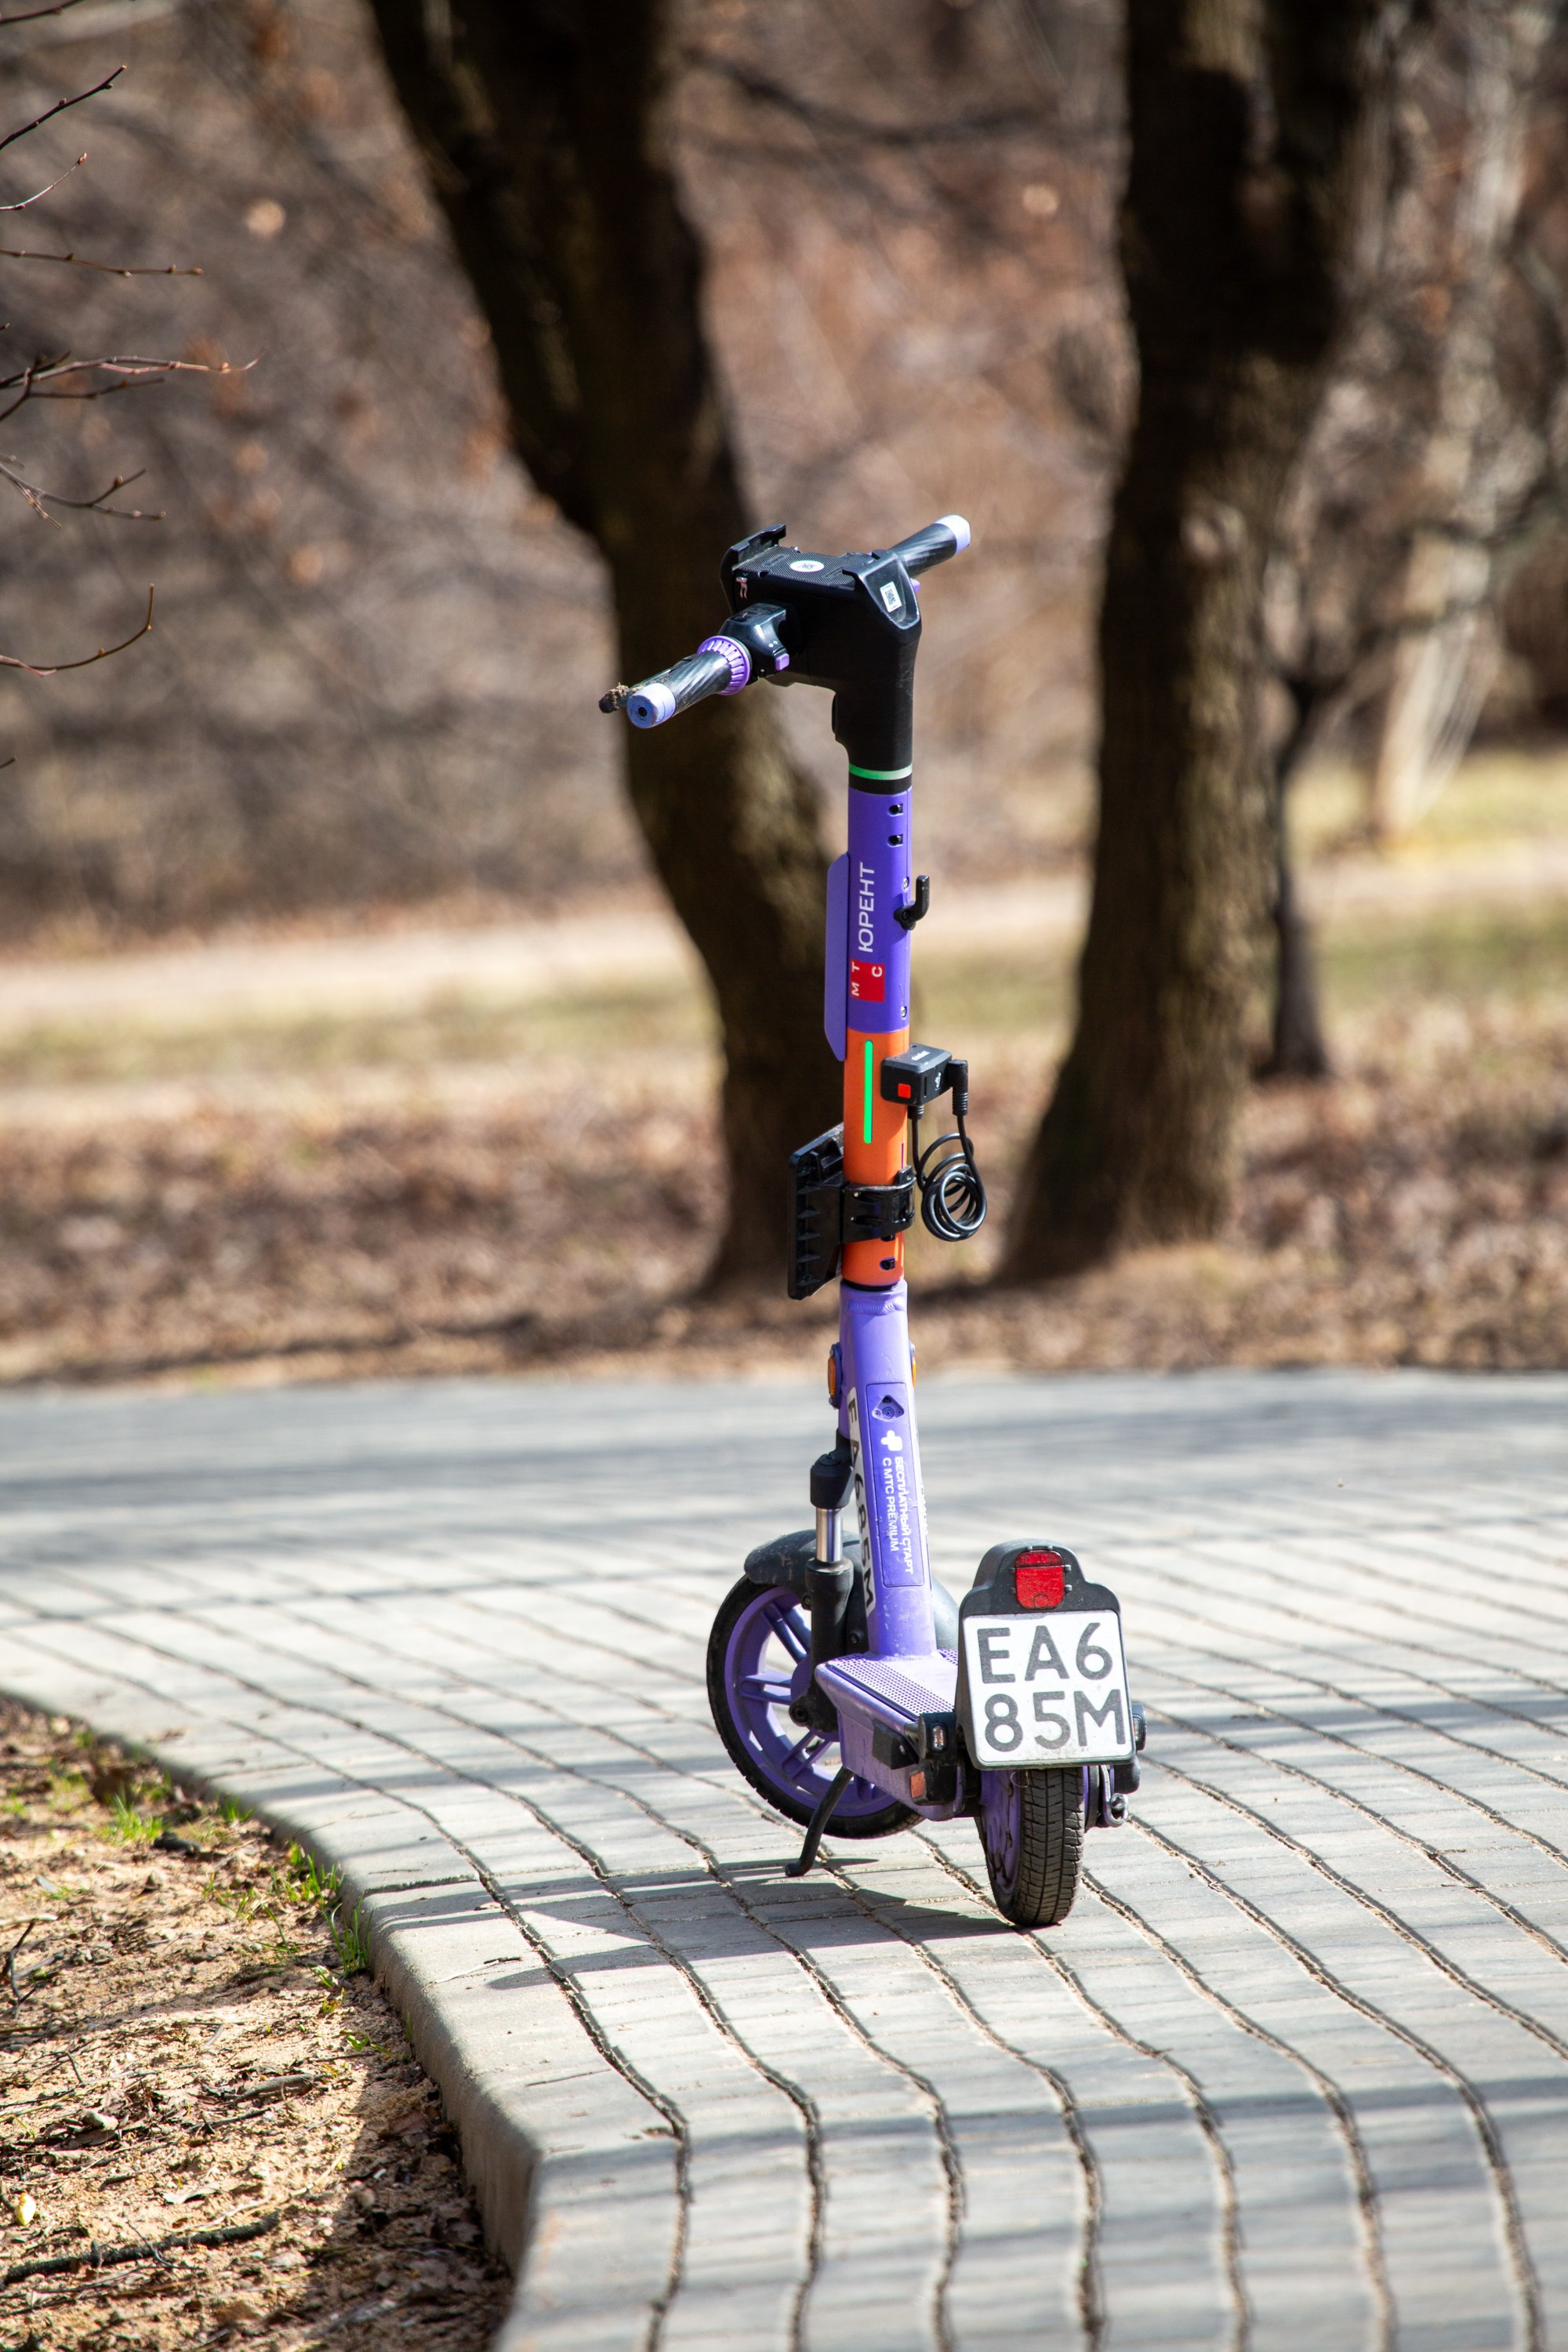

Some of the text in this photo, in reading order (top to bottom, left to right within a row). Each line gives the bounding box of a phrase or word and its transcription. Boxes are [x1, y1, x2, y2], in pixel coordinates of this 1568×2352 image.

[858, 862, 874, 953] ЮРЕНТ
[884, 1468, 895, 1494] МТС
[886, 1496, 899, 1552] PREMIUM
[895, 1456, 913, 1574] БЕСПЛАТНЫЙ СТАРТ
[977, 1622, 1113, 1684] EA6
[985, 1689, 1126, 1752] 85M
